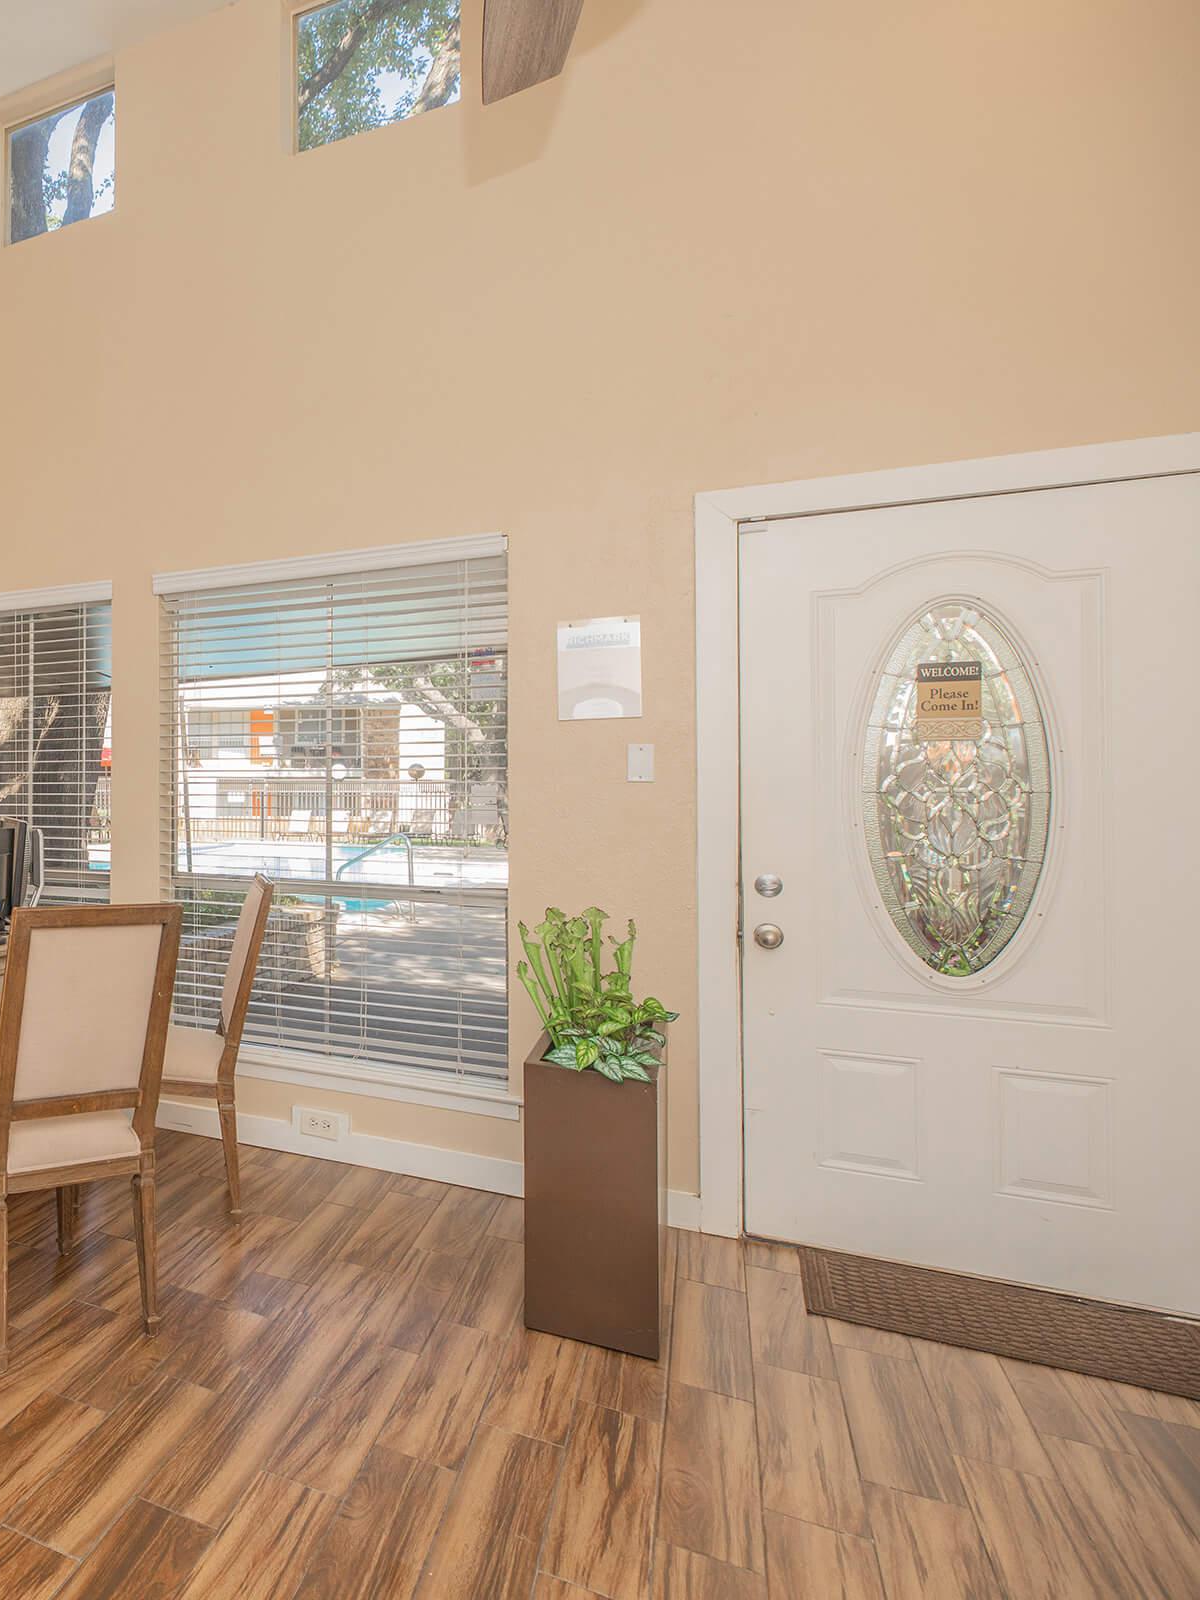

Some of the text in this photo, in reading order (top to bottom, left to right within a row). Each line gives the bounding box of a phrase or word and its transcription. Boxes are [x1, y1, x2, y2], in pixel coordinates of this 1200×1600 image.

[920, 666, 979, 677] WELCOME!
[930, 687, 969, 699] Please
[920, 699, 979, 712] Come In!
